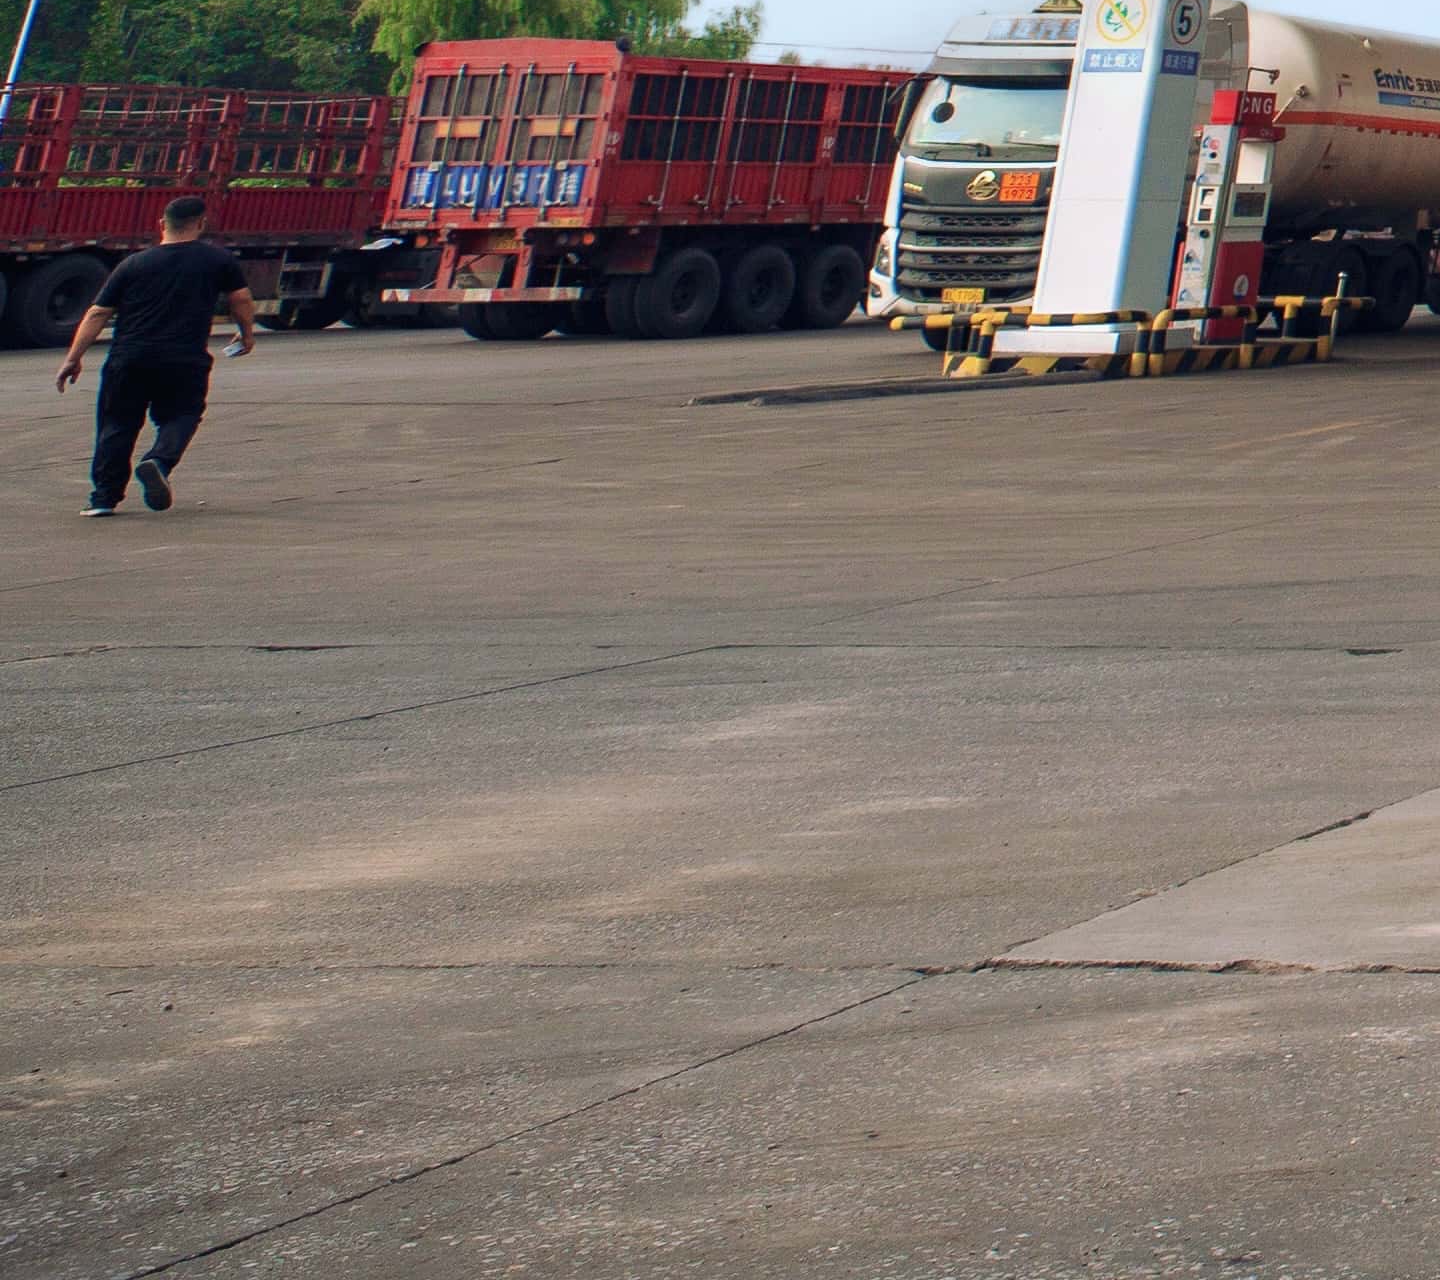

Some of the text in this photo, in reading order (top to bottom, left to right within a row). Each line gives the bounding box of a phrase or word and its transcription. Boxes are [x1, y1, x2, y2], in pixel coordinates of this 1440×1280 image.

[1178, 4, 1193, 36] 5
[1090, 53, 1138, 68] 禁止烟火
[1374, 68, 1414, 93] Enric
[1004, 189, 1034, 200] 1972
